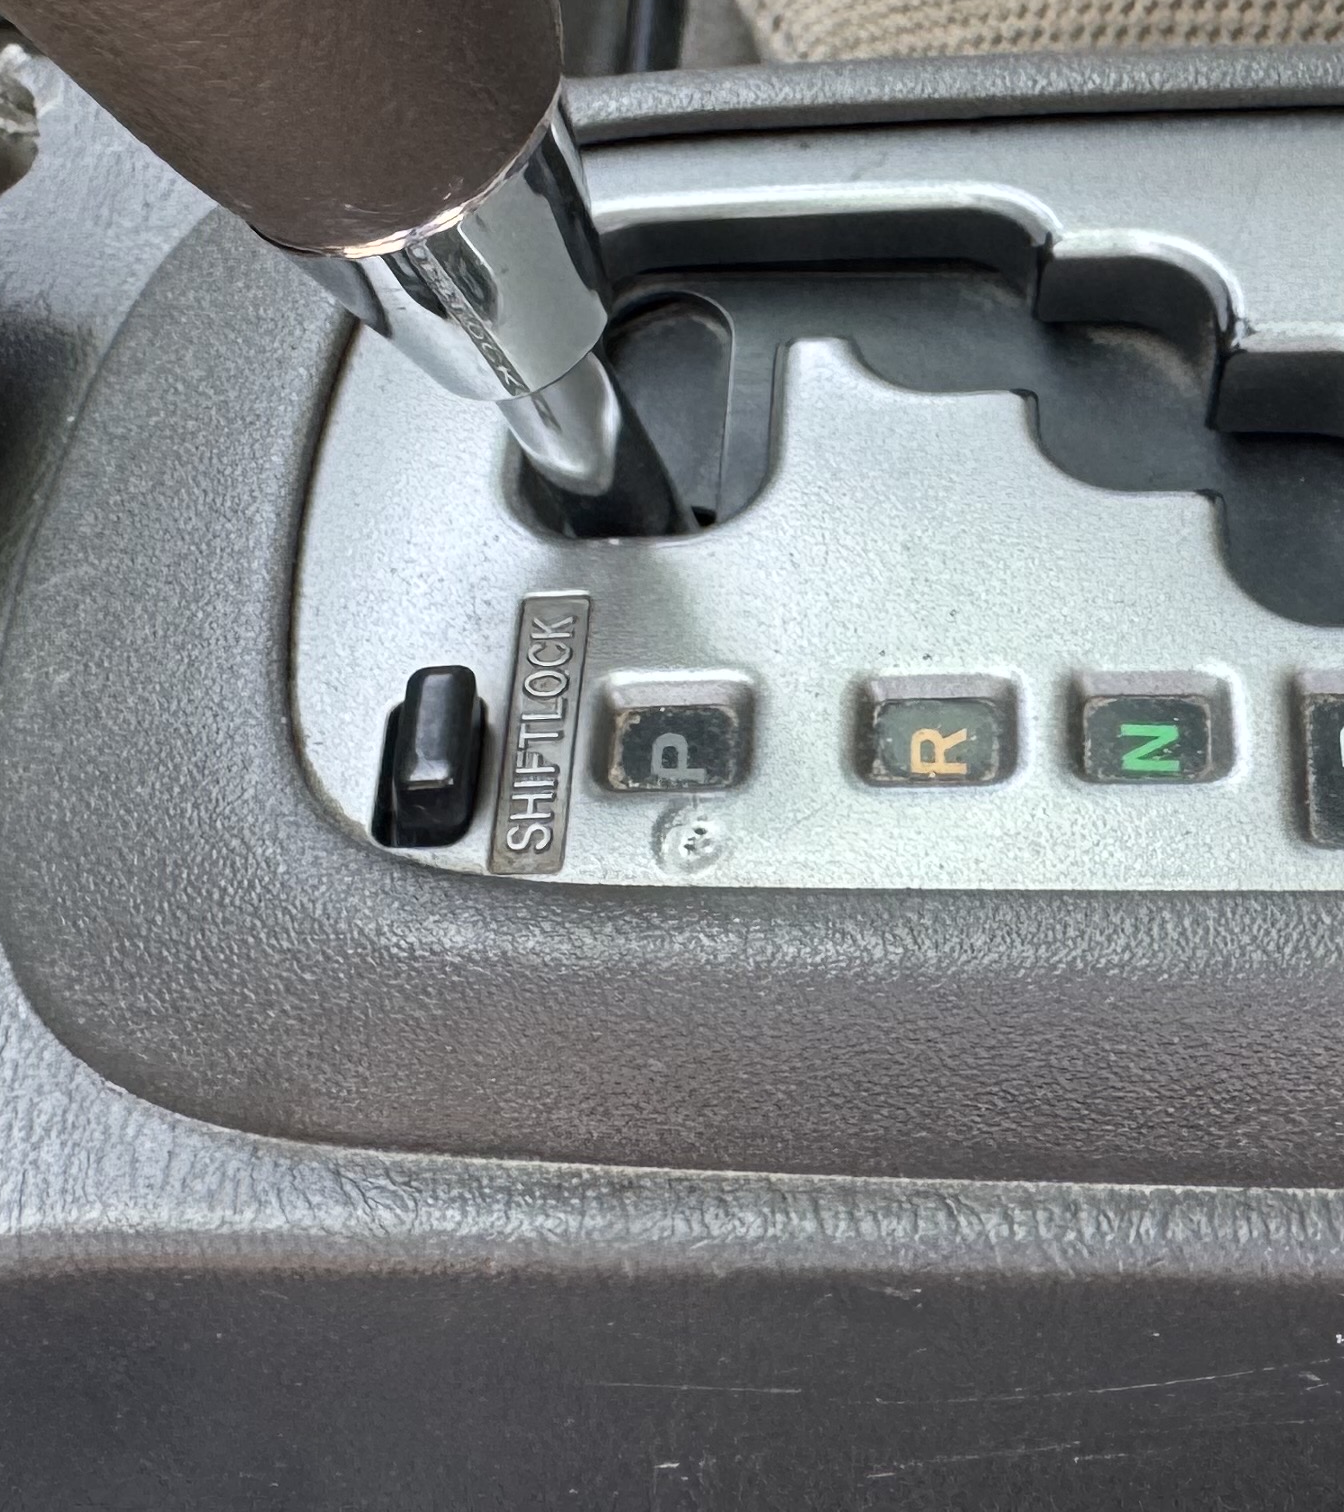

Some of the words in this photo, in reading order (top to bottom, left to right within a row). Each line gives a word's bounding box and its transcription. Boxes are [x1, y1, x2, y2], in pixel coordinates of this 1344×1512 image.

[651, 732, 707, 783] P
[910, 727, 968, 775] R
[1120, 723, 1181, 773] N
